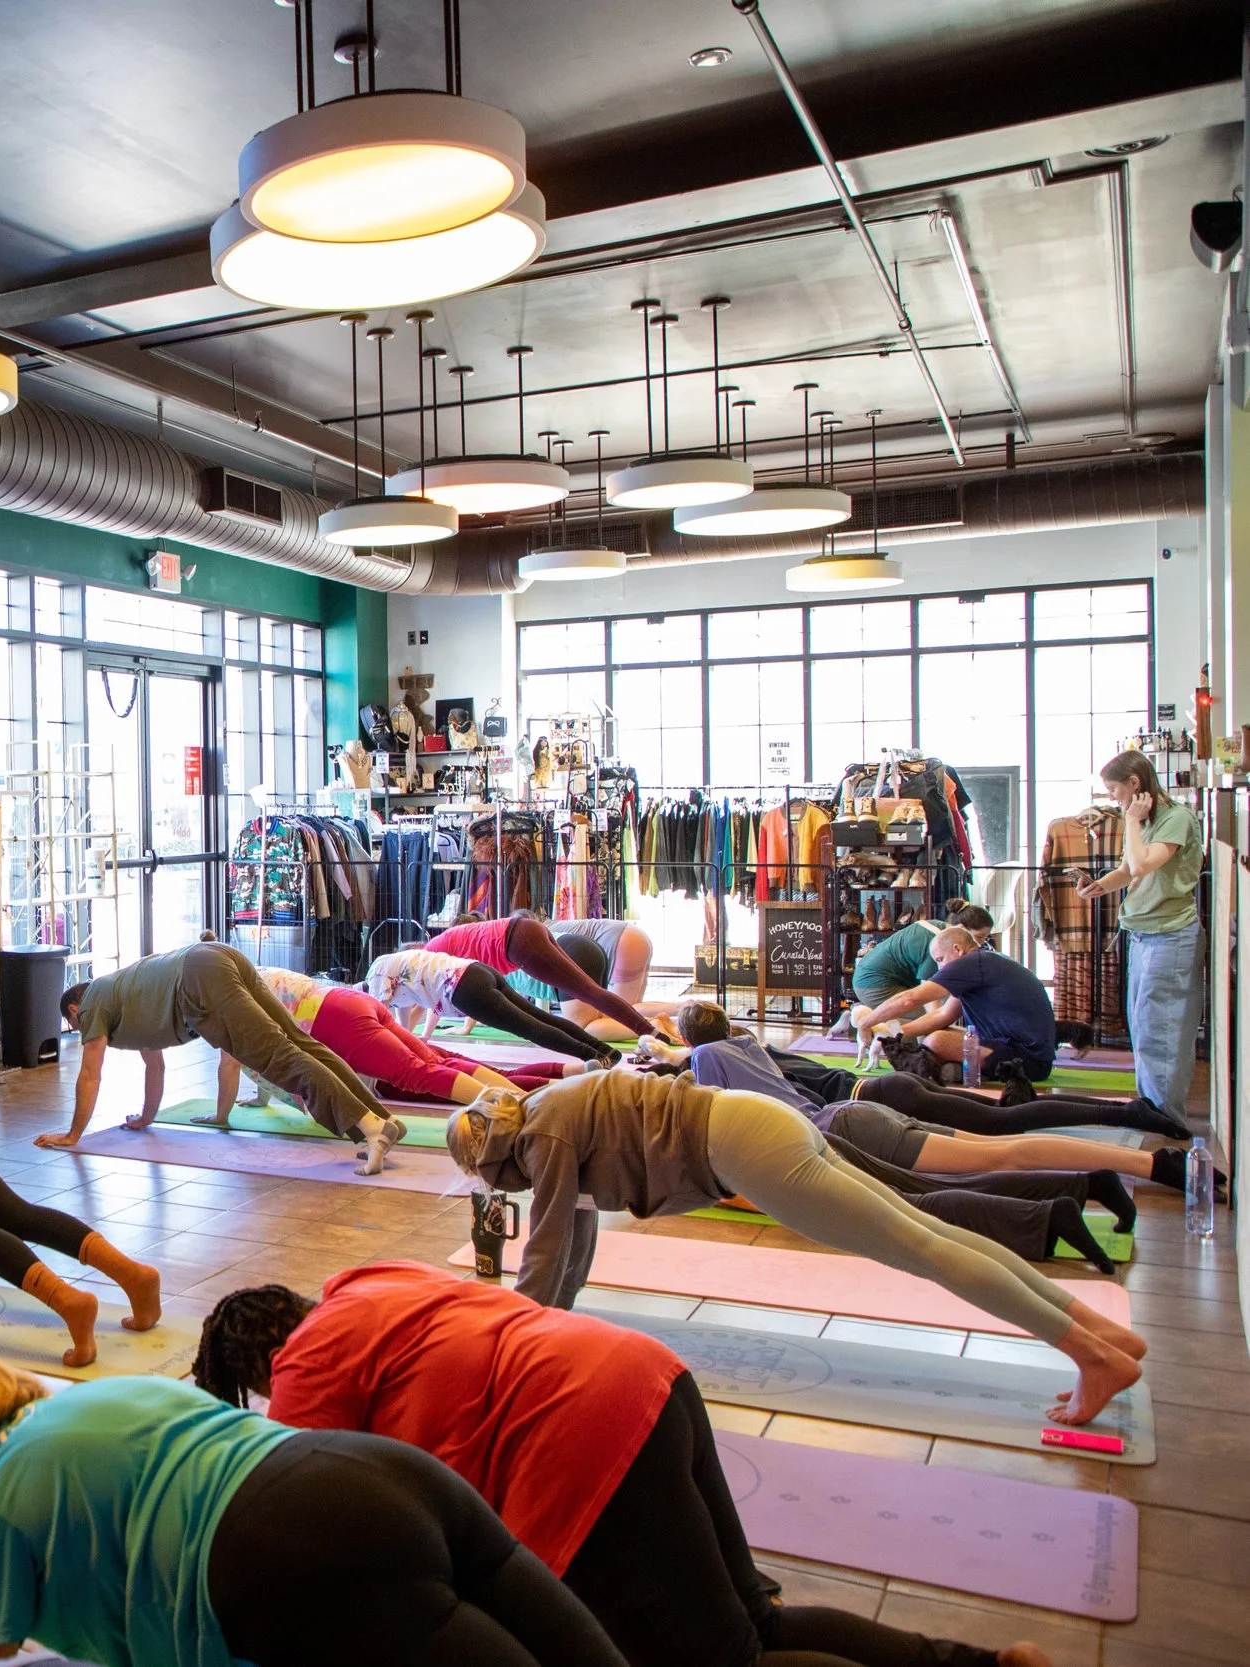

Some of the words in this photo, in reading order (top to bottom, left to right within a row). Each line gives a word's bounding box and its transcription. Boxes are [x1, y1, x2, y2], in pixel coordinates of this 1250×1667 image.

[161, 555, 178, 581] EXIT
[768, 921, 823, 935] HONEYMOO
[787, 931, 805, 939] VTG
